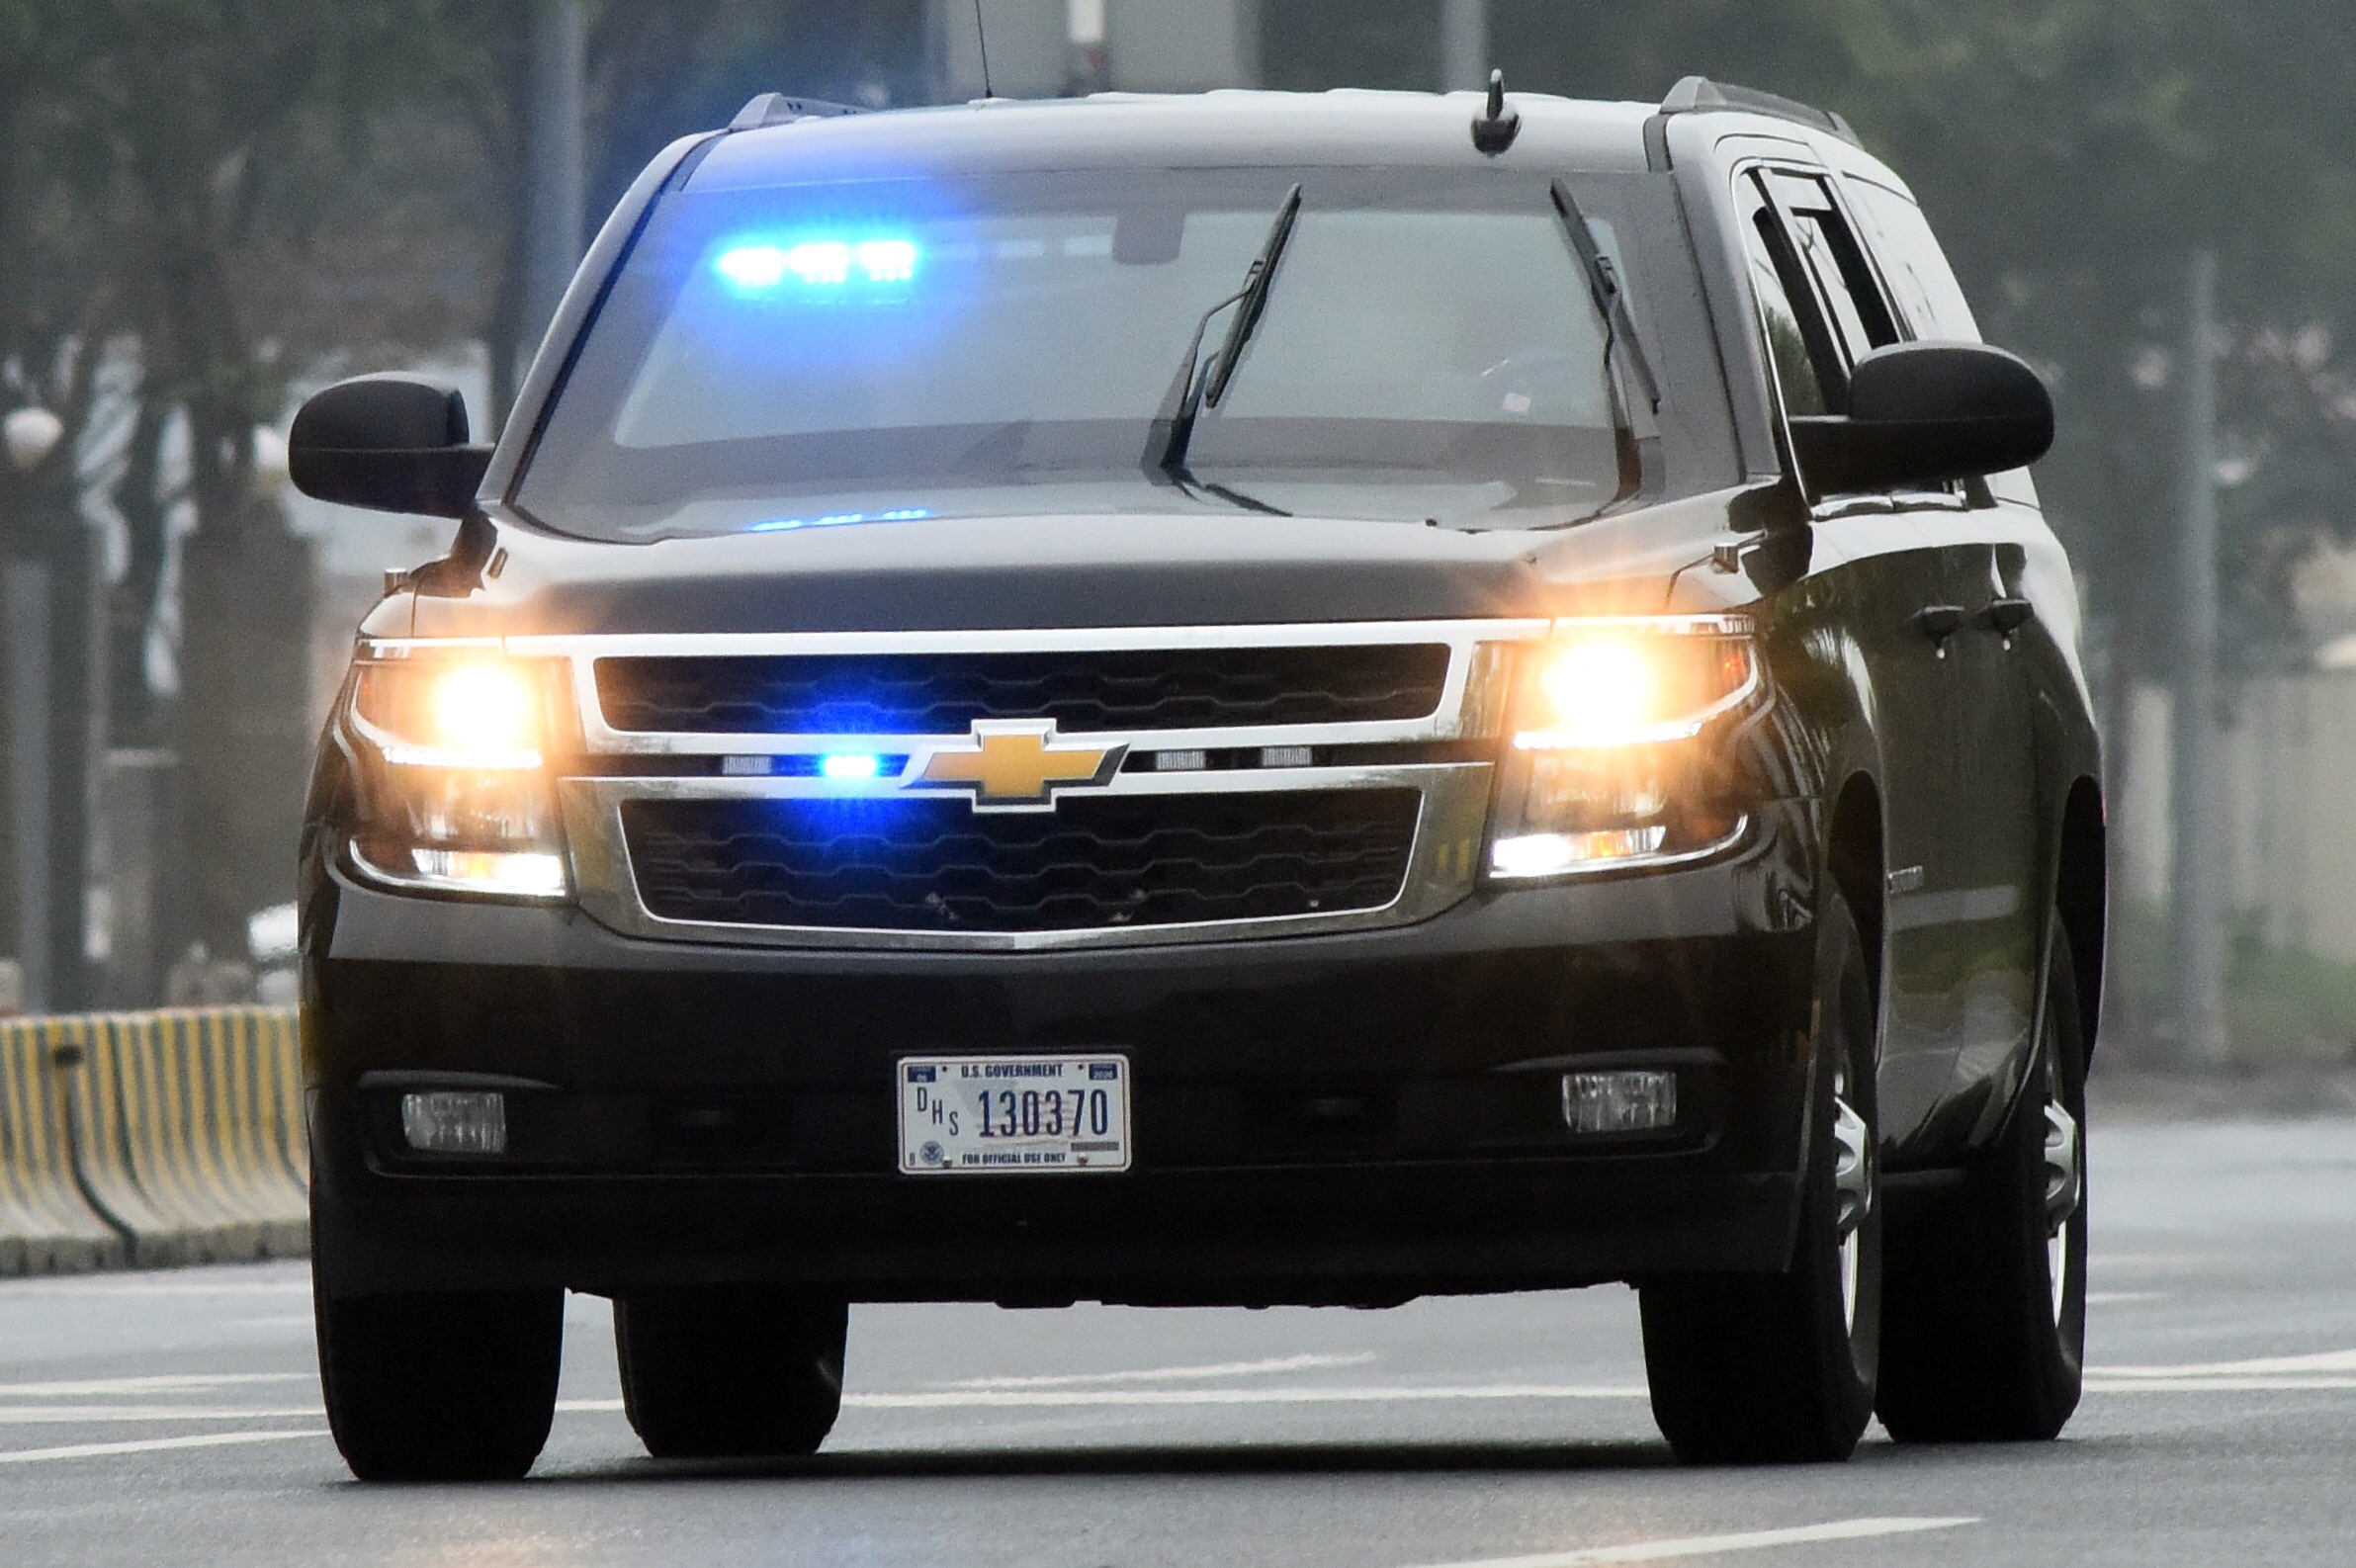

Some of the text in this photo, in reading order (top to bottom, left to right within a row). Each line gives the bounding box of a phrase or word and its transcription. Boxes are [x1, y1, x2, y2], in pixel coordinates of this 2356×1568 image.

[961, 1063, 1063, 1078] U.S. GOVERNMENT
[979, 1089, 1108, 1138] 130370
[962, 1152, 1066, 1165] FOR OFFICIAL USE ONLY
